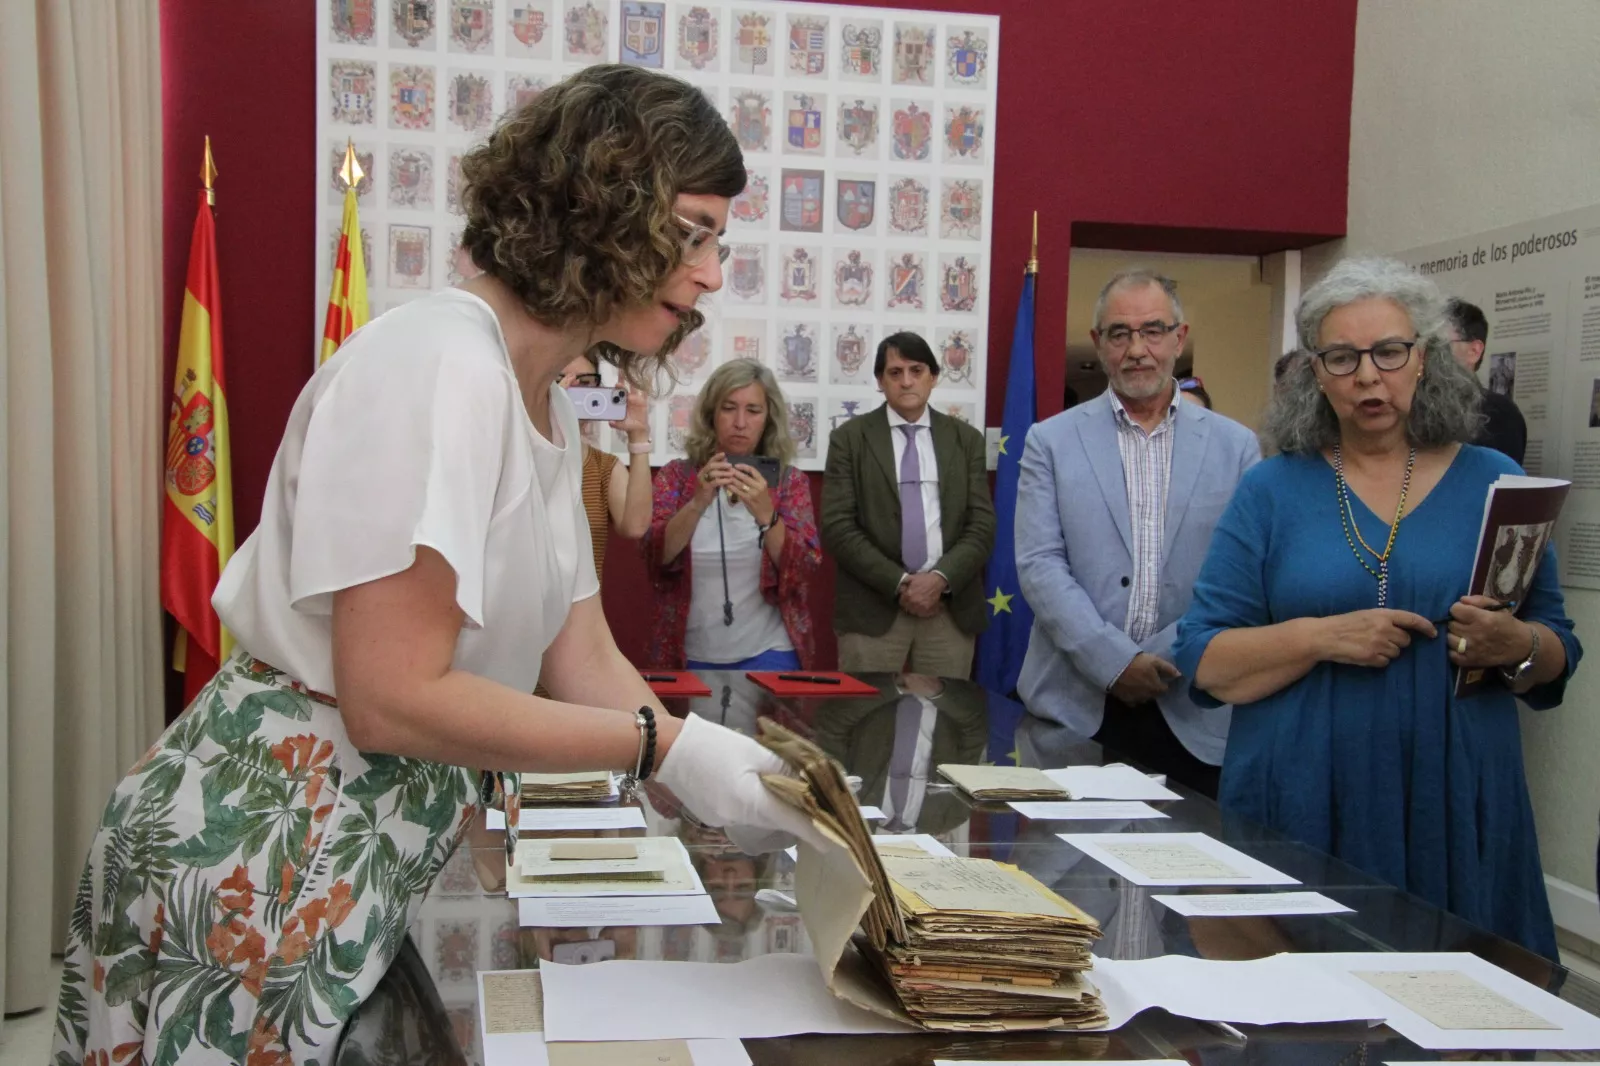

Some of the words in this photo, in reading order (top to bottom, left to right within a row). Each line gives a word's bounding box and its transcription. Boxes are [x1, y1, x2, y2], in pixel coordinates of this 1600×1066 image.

[1420, 250, 1468, 276] memoria
[1472, 246, 1486, 266] de
[1490, 242, 1508, 262] los
[1511, 229, 1578, 264] poderosos
